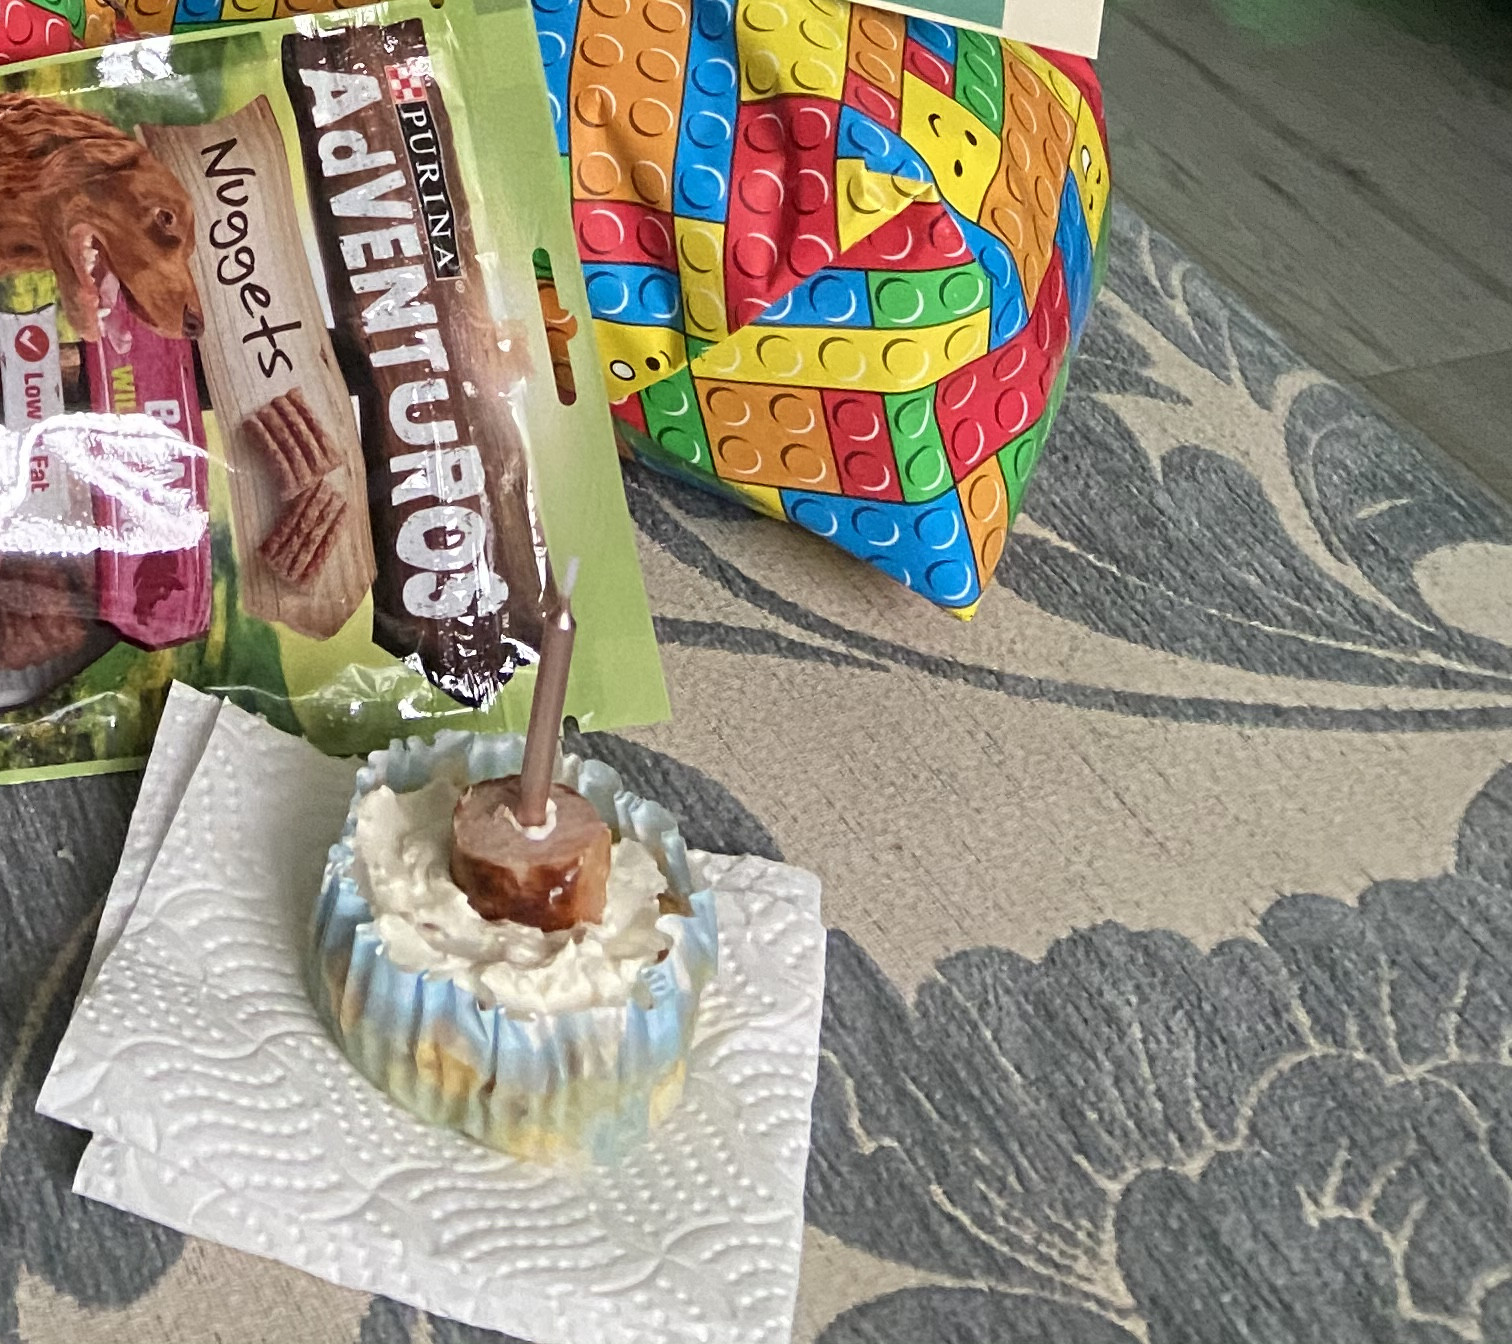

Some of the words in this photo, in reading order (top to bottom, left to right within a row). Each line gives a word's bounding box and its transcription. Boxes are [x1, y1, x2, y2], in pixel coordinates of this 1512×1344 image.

[400, 107, 456, 270] PURINA
[199, 137, 303, 380] Nuggets
[23, 372, 45, 421] Low
[29, 454, 51, 494] Fat
